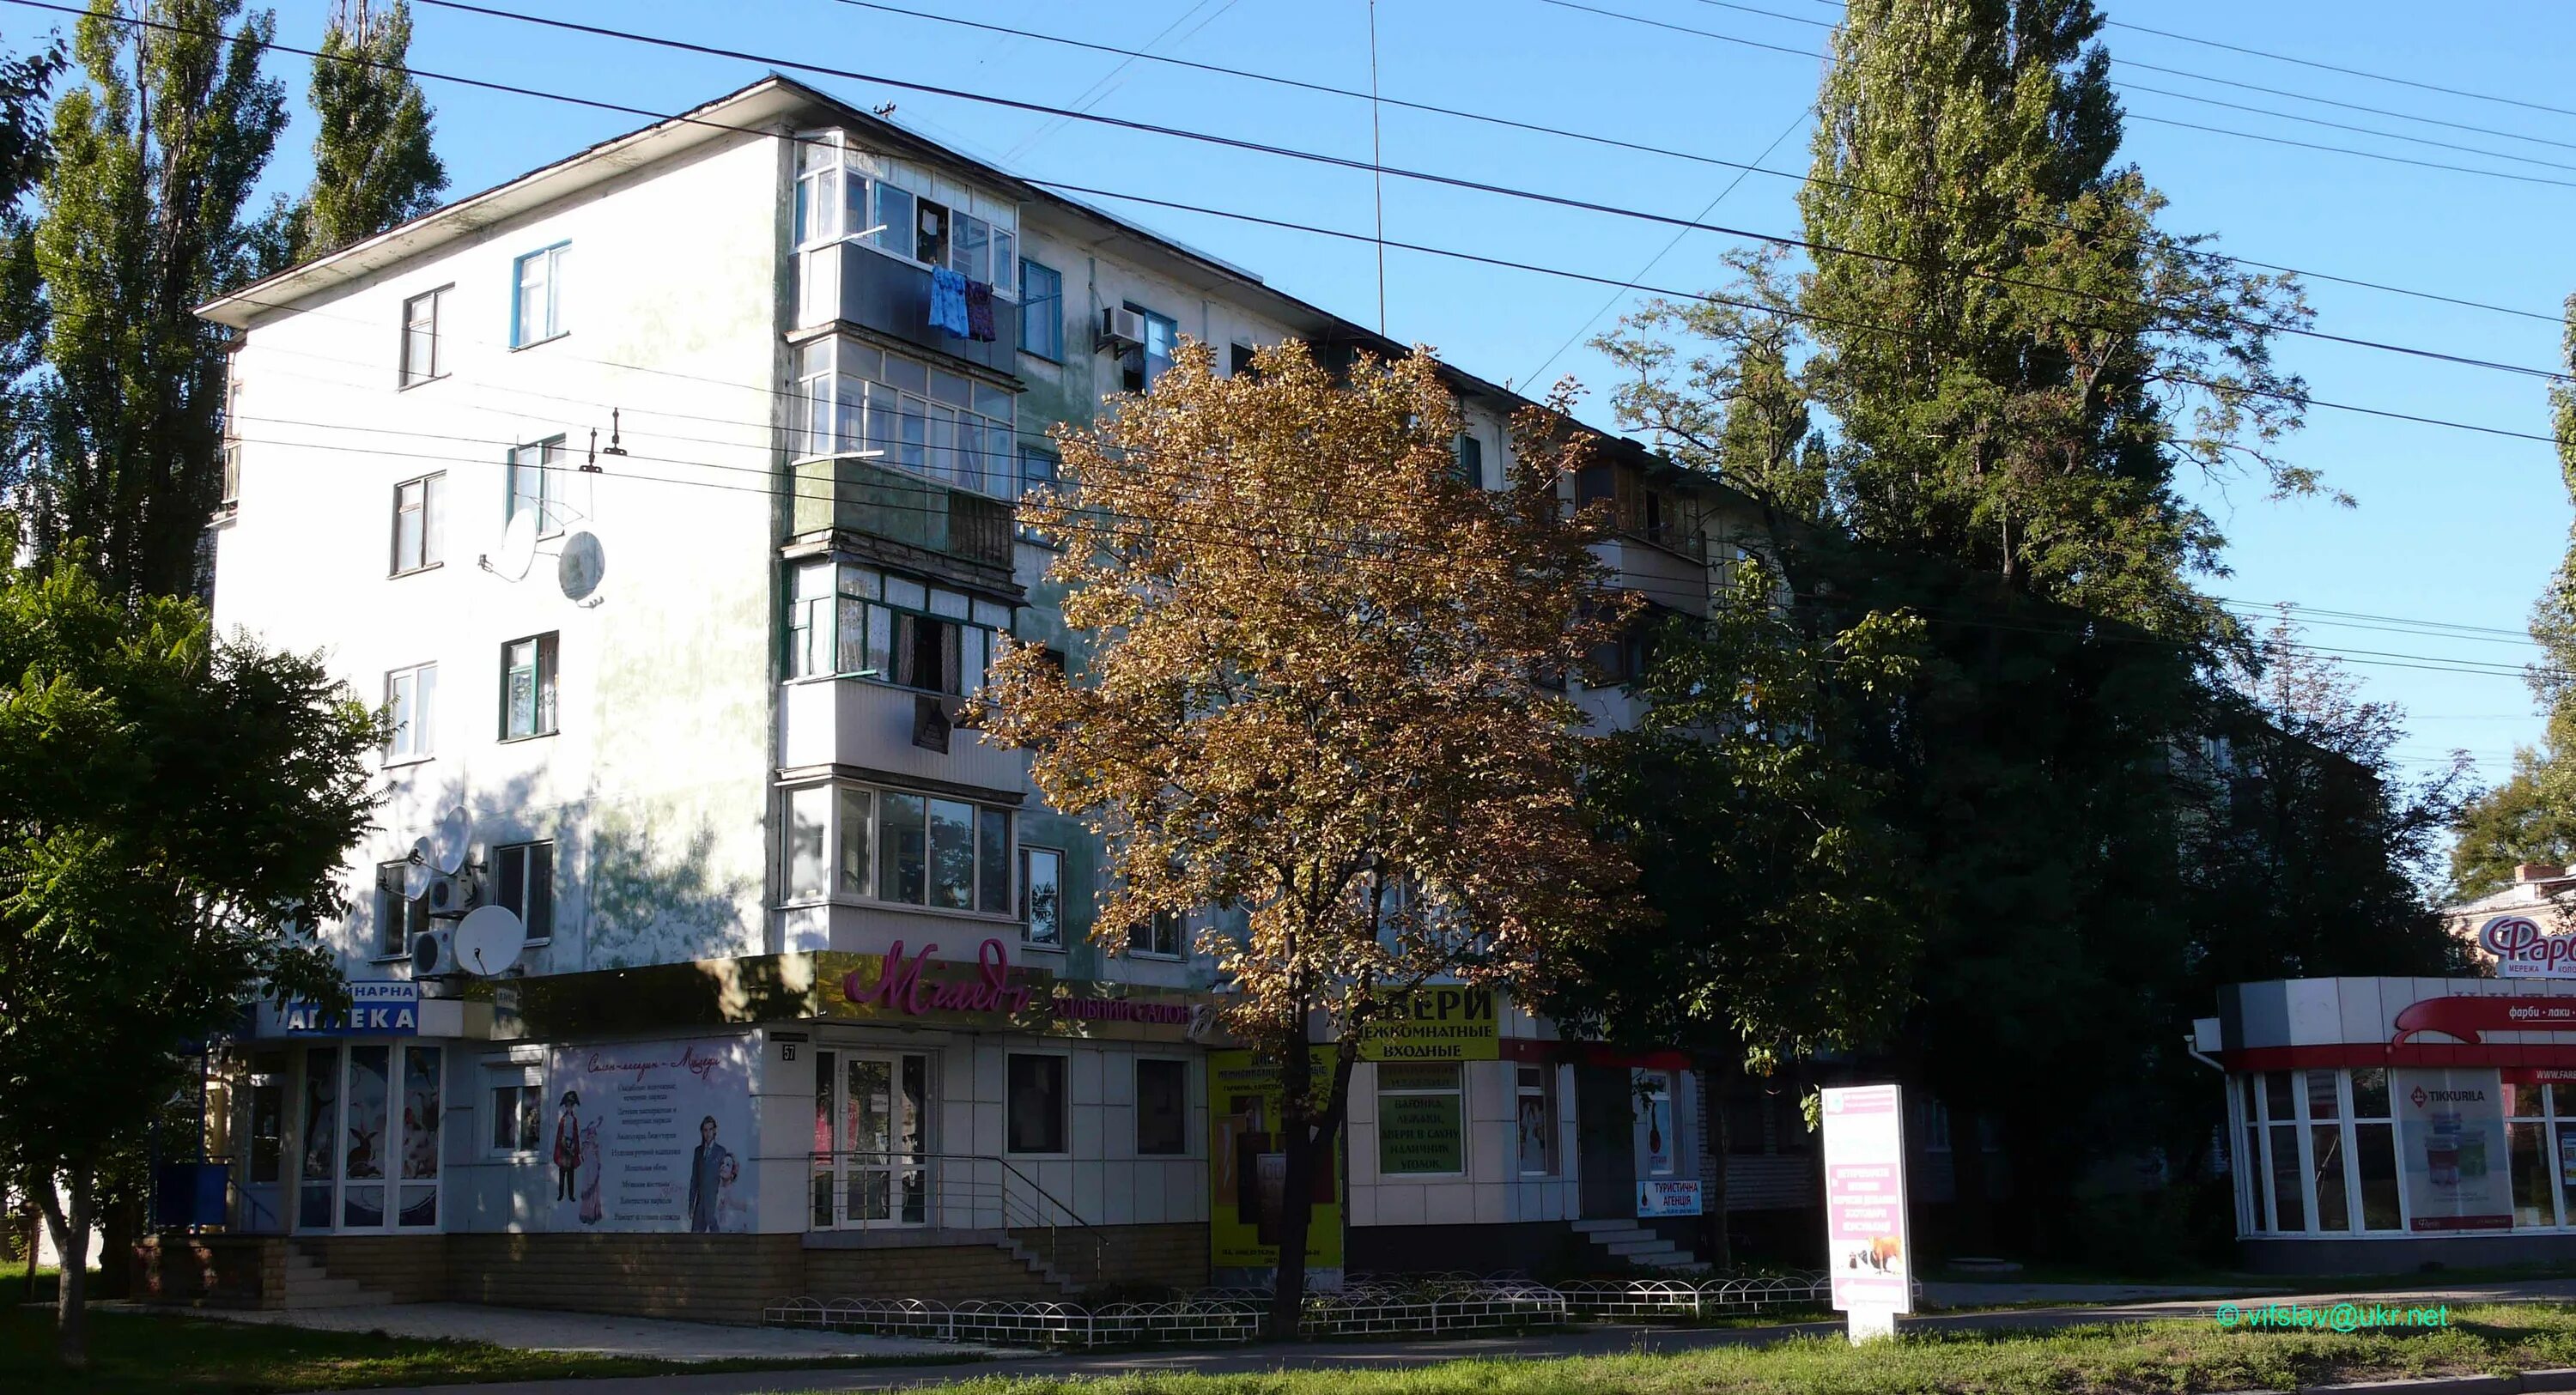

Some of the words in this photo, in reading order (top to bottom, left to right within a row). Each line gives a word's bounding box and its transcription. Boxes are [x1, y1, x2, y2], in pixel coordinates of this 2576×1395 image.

[2509, 964, 2539, 973] МЕРЕЖА
[2509, 1004, 2539, 1020] фарби
[2548, 1008, 2570, 1017] лаки
[784, 1045, 794, 1060] 57
[1383, 1045, 1461, 1058] ВХОДНЫЕ
[2429, 1089, 2485, 1102] TIKKURILA
[1655, 1182, 1698, 1193] ТУРИСТИЧНА
[1663, 1195, 1692, 1208] АГЕНЦІЯ
